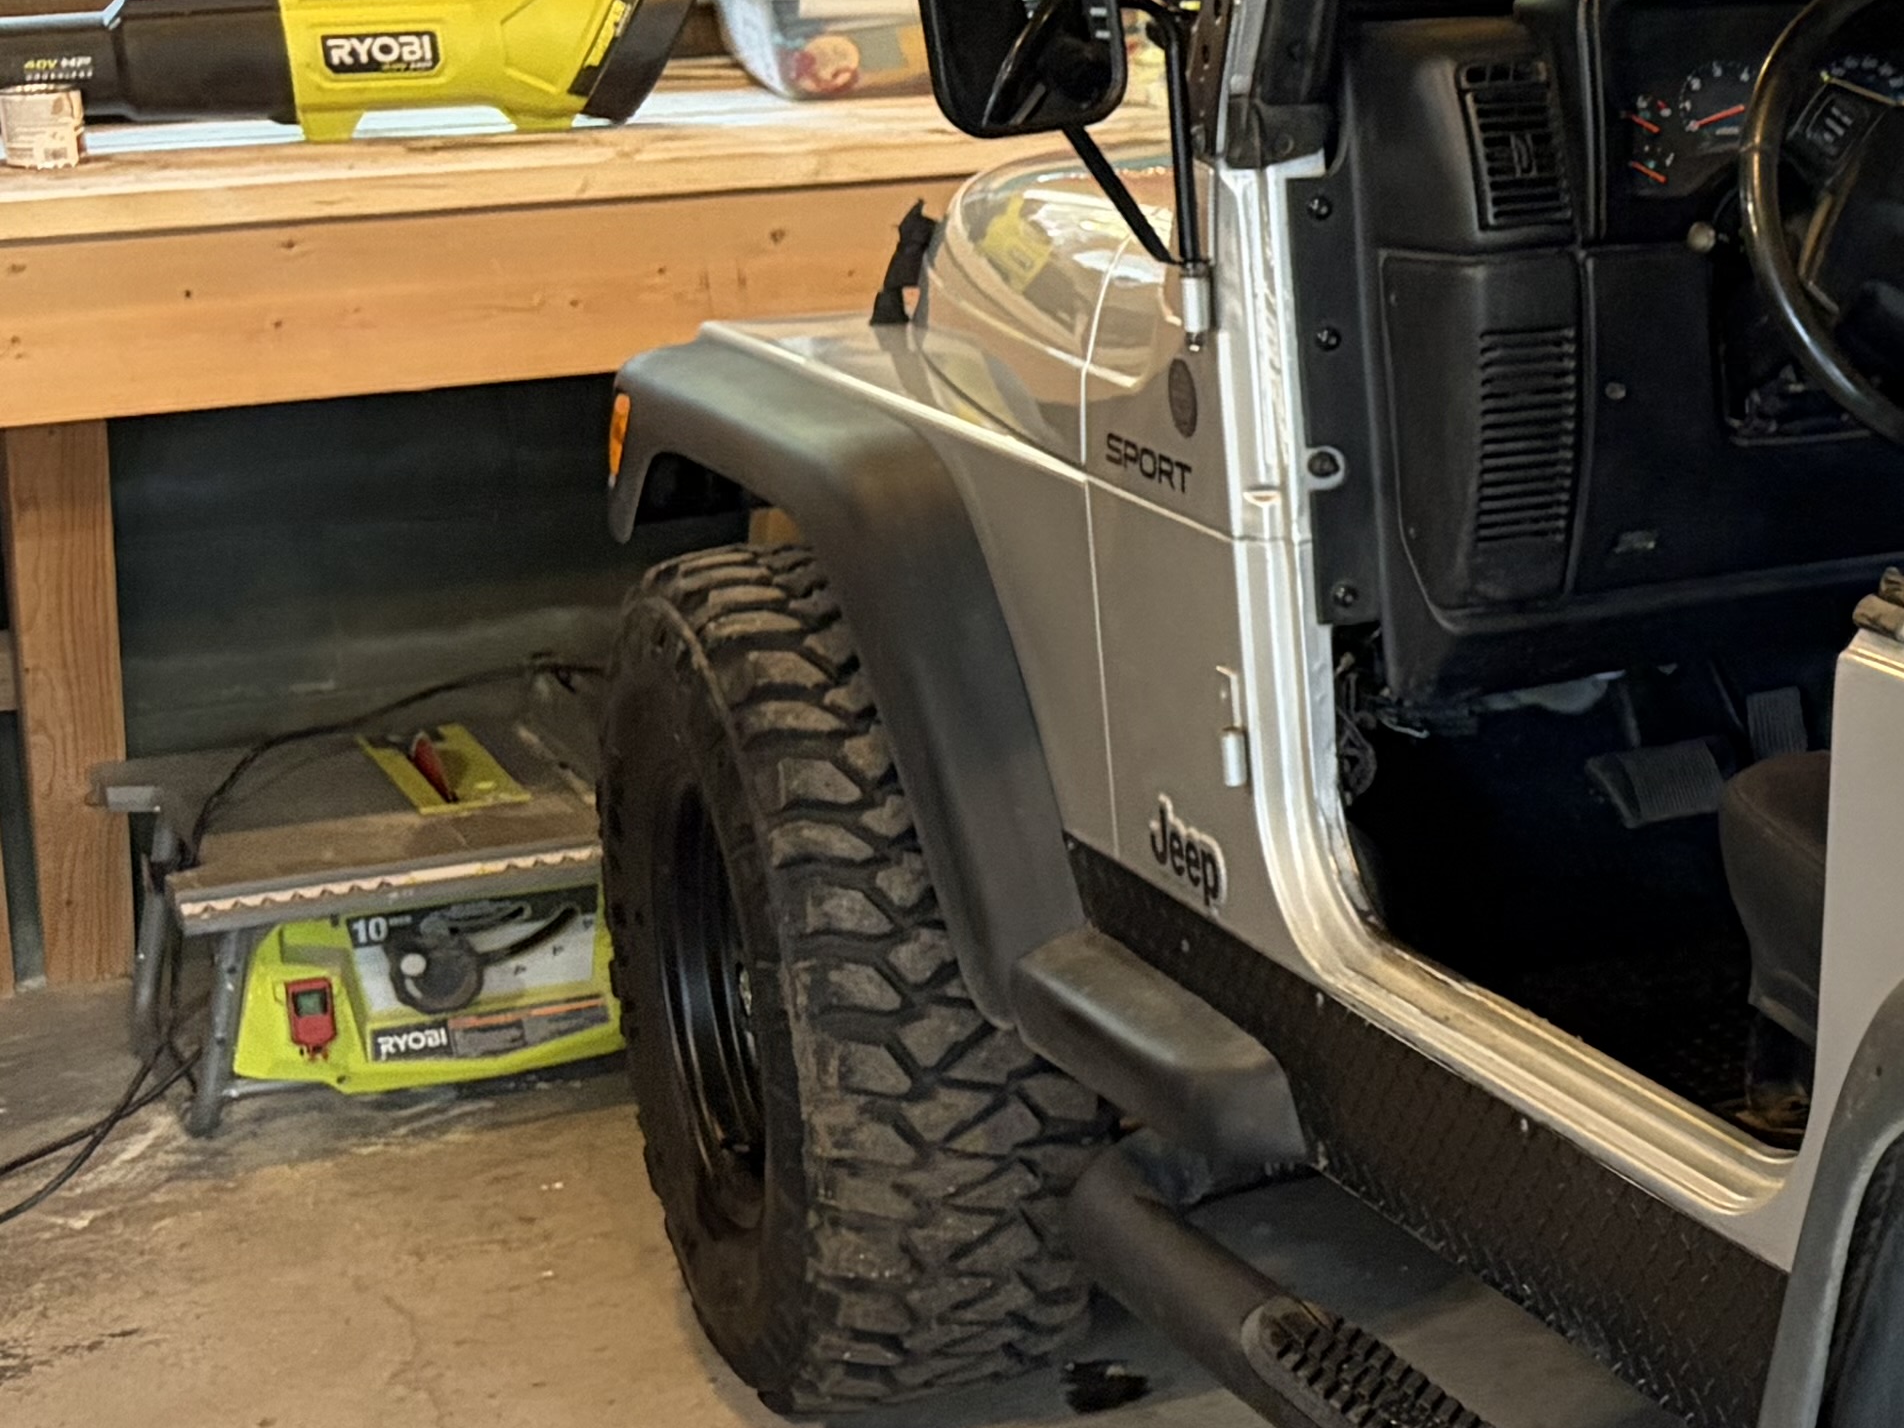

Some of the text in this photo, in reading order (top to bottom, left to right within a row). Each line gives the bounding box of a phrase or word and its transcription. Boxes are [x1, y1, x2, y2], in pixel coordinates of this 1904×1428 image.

[326, 35, 433, 68] RYOBI
[1106, 432, 1193, 494] SPORT
[1149, 796, 1225, 914] Jeep
[353, 916, 388, 945] 10
[377, 1027, 448, 1061] RYOBI
